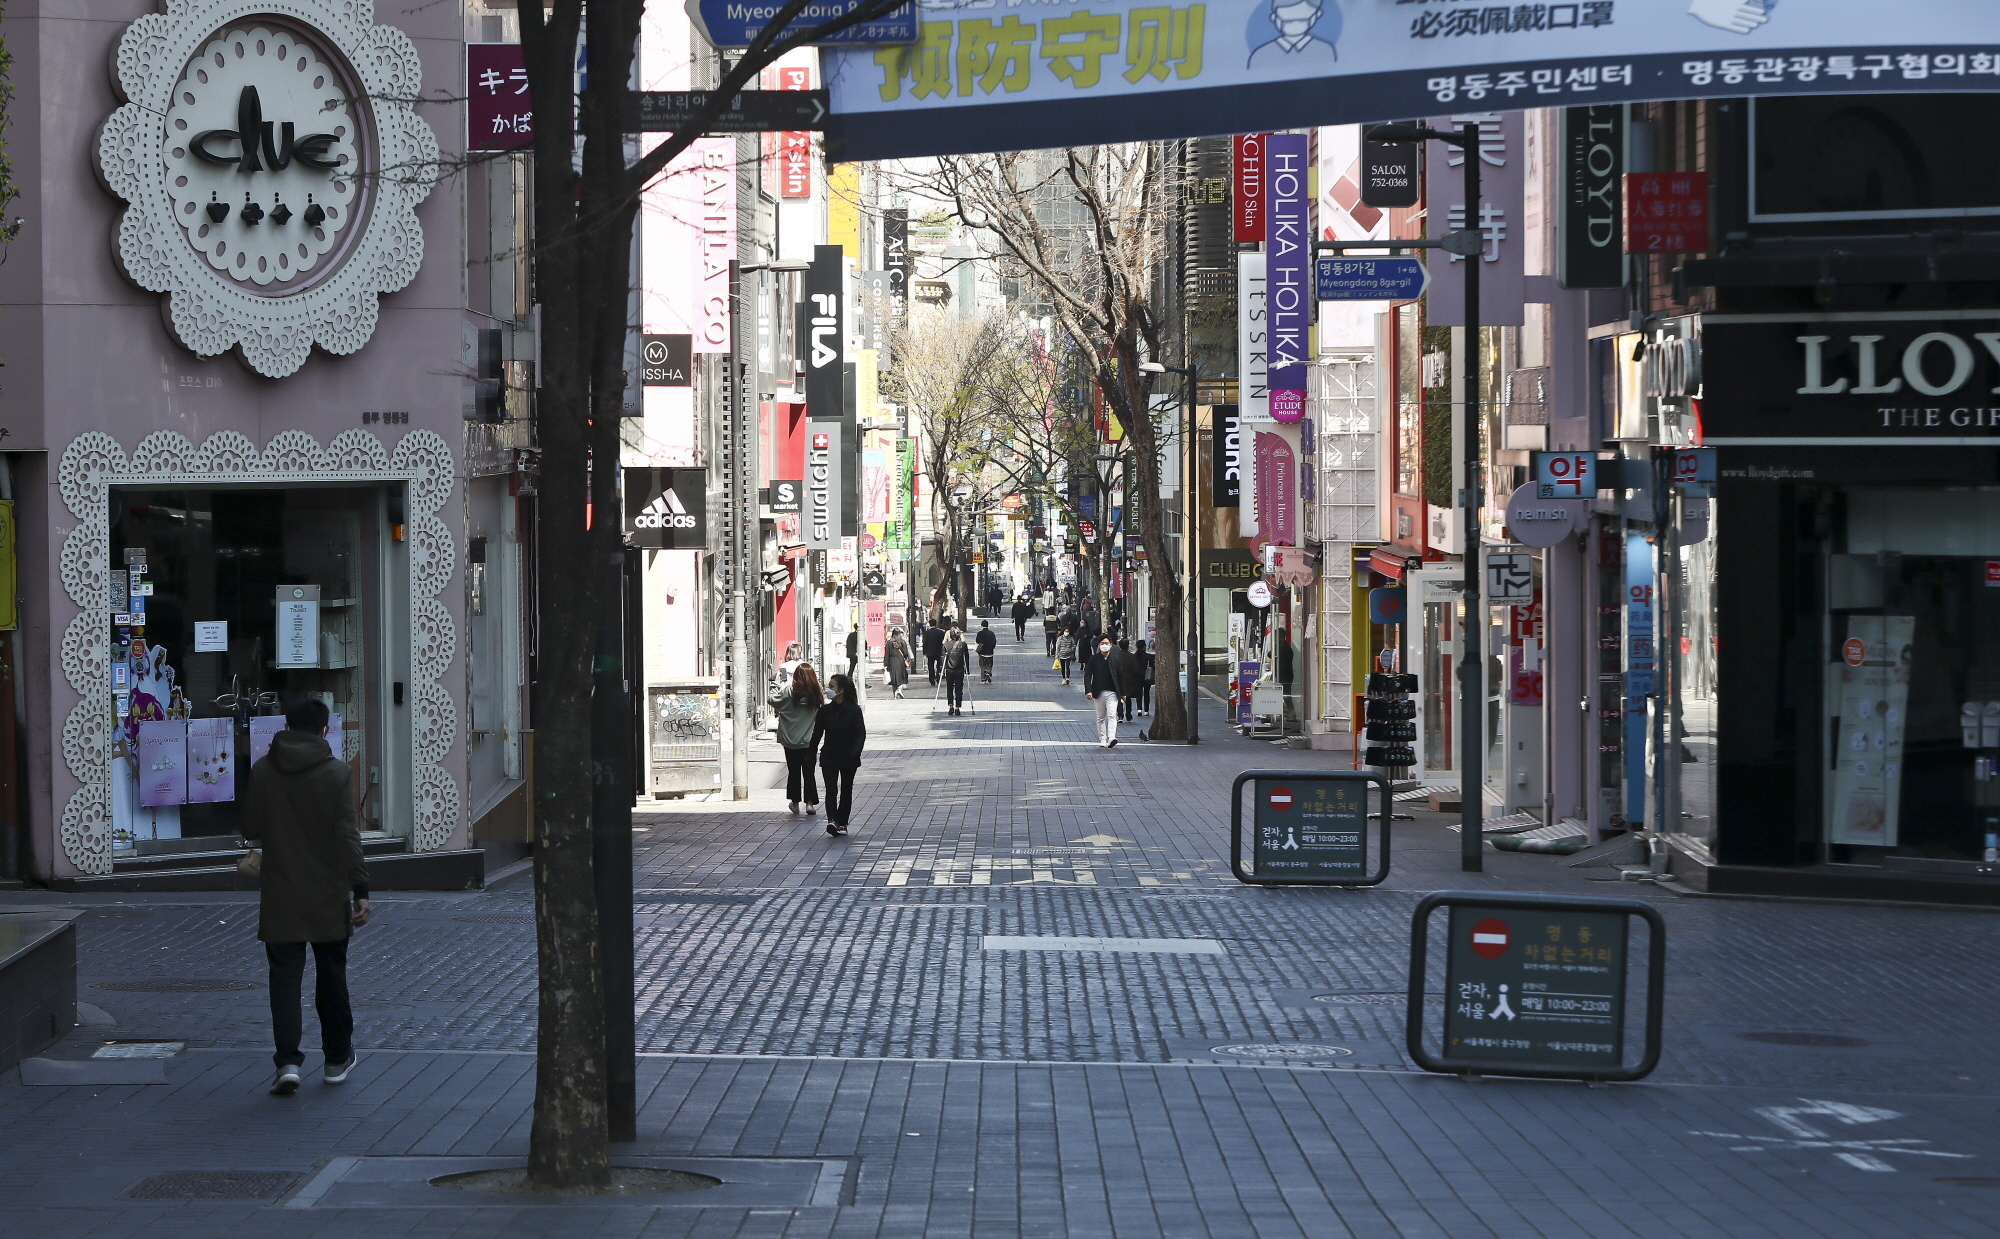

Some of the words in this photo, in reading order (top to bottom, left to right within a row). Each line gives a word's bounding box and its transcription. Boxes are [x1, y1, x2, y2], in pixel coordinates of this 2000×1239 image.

[1410, 1, 1615, 40] 必须佩戴口罩
[873, 4, 1205, 102] 预防守则
[1426, 63, 1633, 103] 명동주민센터
[788, 151, 807, 193] skin
[1242, 132, 1259, 198] RCHID
[1371, 165, 1407, 175] SALON
[1588, 106, 1614, 248] LOYD
[1371, 178, 1408, 188] 752-0368
[703, 150, 728, 282] BANILA
[1245, 200, 1258, 228] Skin
[1275, 154, 1299, 257] HOLIKA
[1320, 262, 1376, 276] 명동8가길
[1320, 278, 1378, 289] Myeongdong
[1379, 278, 1411, 289] 8ga-gil
[703, 292, 730, 345] CO
[811, 293, 837, 369] FILA
[1275, 267, 1299, 369] HOLIKA
[643, 368, 684, 381] ISSHA
[1274, 401, 1302, 410] ETUDE
[1877, 407, 1942, 427] THE
[895, 452, 905, 487] Nature
[1277, 462, 1286, 500] Princess
[1549, 455, 1587, 496] 약
[810, 449, 830, 541] swatch
[634, 513, 696, 528] adidas
[895, 488, 905, 539] Collection
[1277, 503, 1286, 531] House
[1515, 507, 1567, 521] heimish
[1209, 562, 1250, 579] CLUB
[1262, 826, 1283, 838] 걷자,
[1262, 839, 1281, 851] 서울
[1302, 835, 1316, 843] 매일
[1318, 835, 1358, 843] 10:00~23:00
[1458, 982, 1492, 1000] 걷자,
[1521, 997, 1544, 1010] 매일
[1547, 998, 1611, 1012] 10:00~23:00
[1457, 1002, 1485, 1020] 서울
